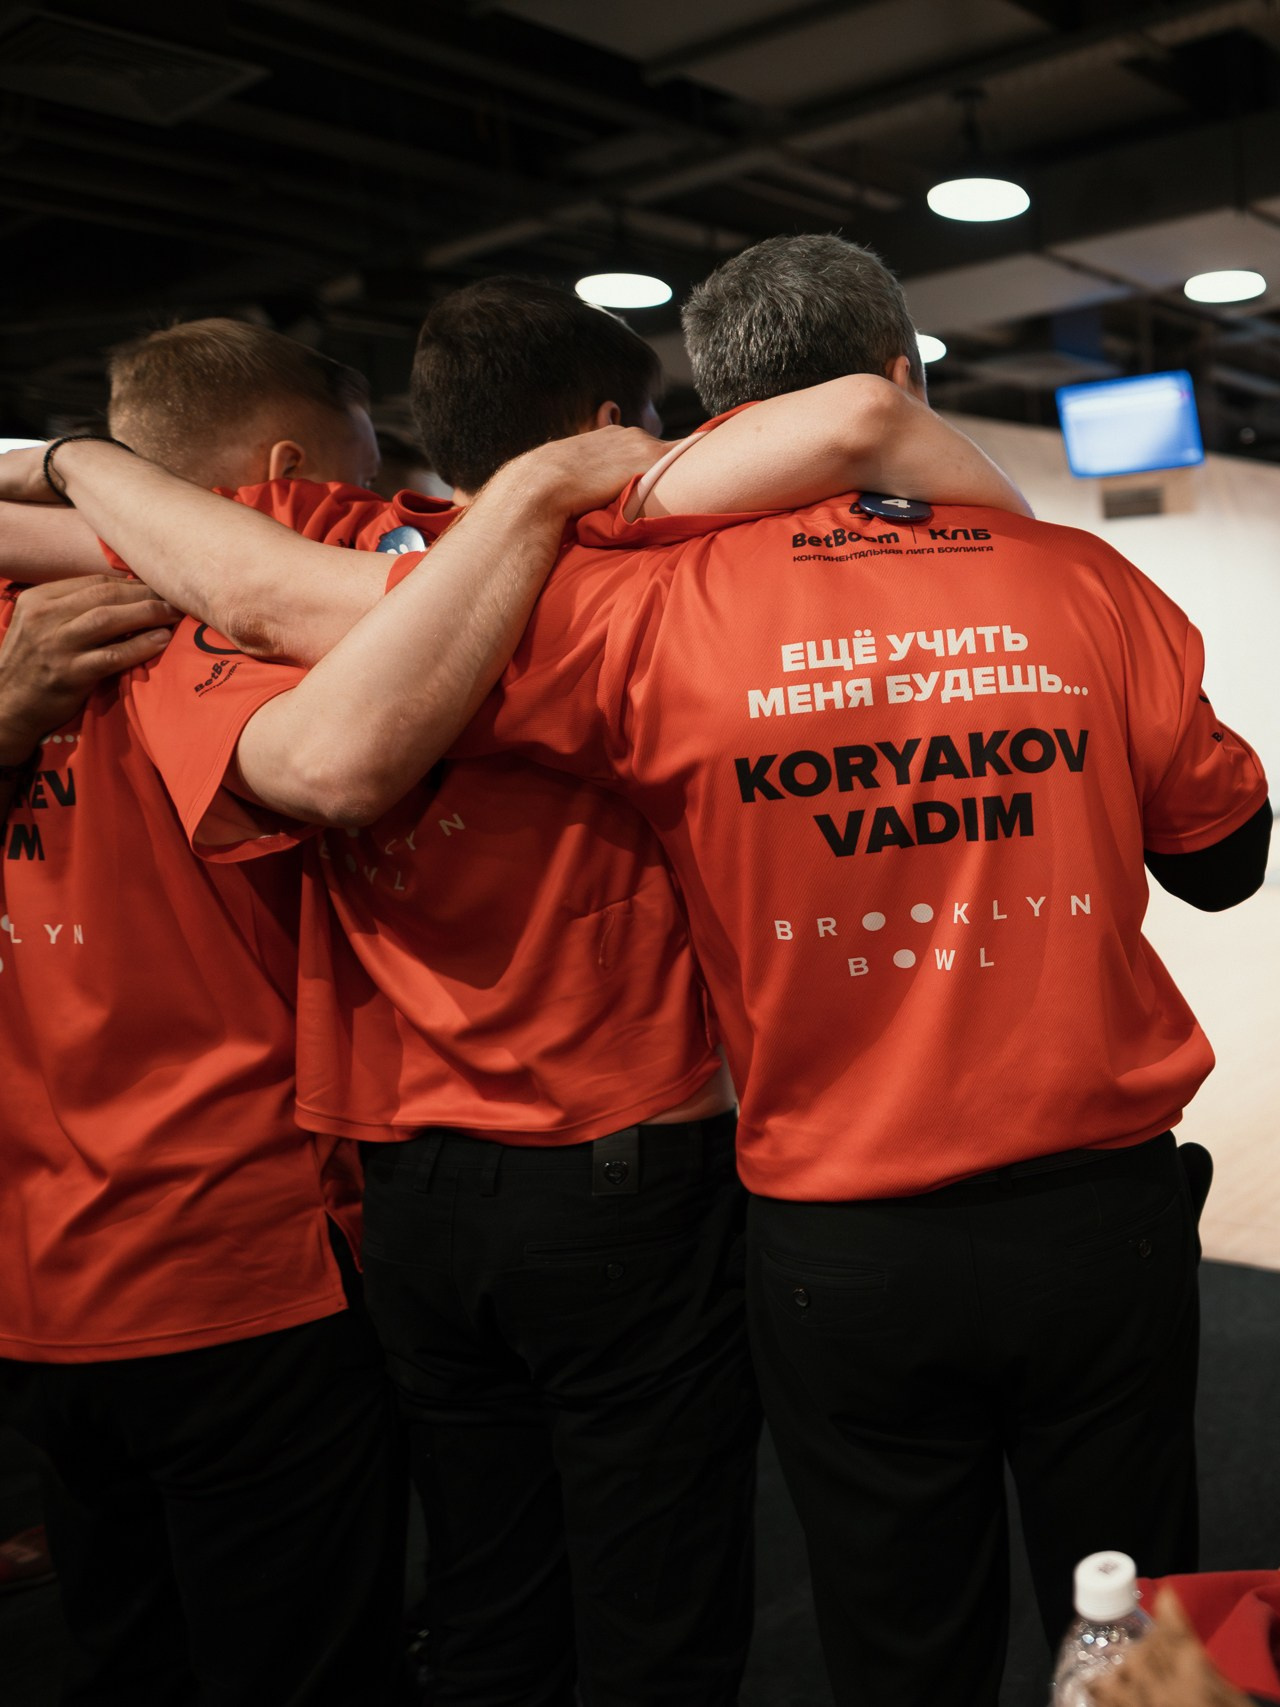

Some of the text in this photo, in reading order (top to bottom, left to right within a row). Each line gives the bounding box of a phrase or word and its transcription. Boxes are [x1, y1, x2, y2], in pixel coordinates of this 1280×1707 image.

[906, 547, 935, 555] ЛИГА
[937, 545, 994, 554] БОУЛИНГА
[928, 528, 992, 541] КЛБ
[781, 625, 1029, 673] ЕЩЁ УЧИТЬ
[747, 664, 1090, 719] МЕНЯ БУДЕШЬ...
[13, 767, 77, 809] EV
[734, 728, 1089, 803] KORYAKOV
[0, 823, 46, 861] M
[812, 792, 1035, 858] VADIM
